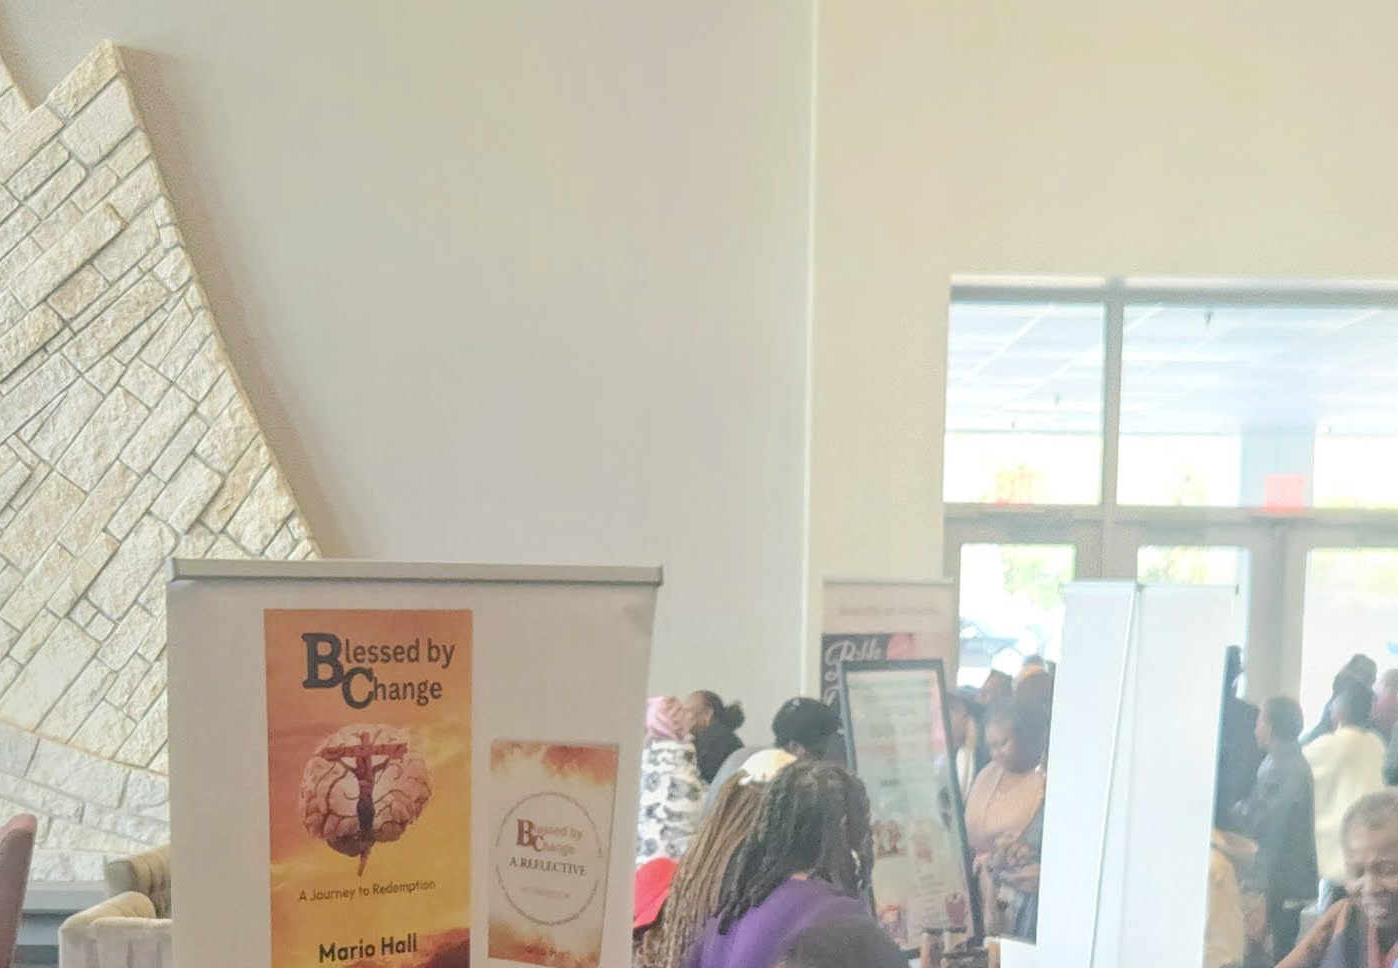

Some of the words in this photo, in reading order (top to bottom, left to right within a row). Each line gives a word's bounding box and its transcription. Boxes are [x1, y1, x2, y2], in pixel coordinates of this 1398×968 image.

[301, 633, 420, 689] Blessed
[427, 637, 456, 669] by
[342, 666, 443, 709] Change
[509, 856, 517, 867] A
[520, 857, 587, 877] REFLECTIVE
[299, 890, 307, 900] A
[309, 888, 356, 901] Journey
[358, 885, 370, 896] to
[372, 880, 436, 895] Redemption
[319, 938, 376, 963] Mario
[381, 932, 417, 956] Hall
